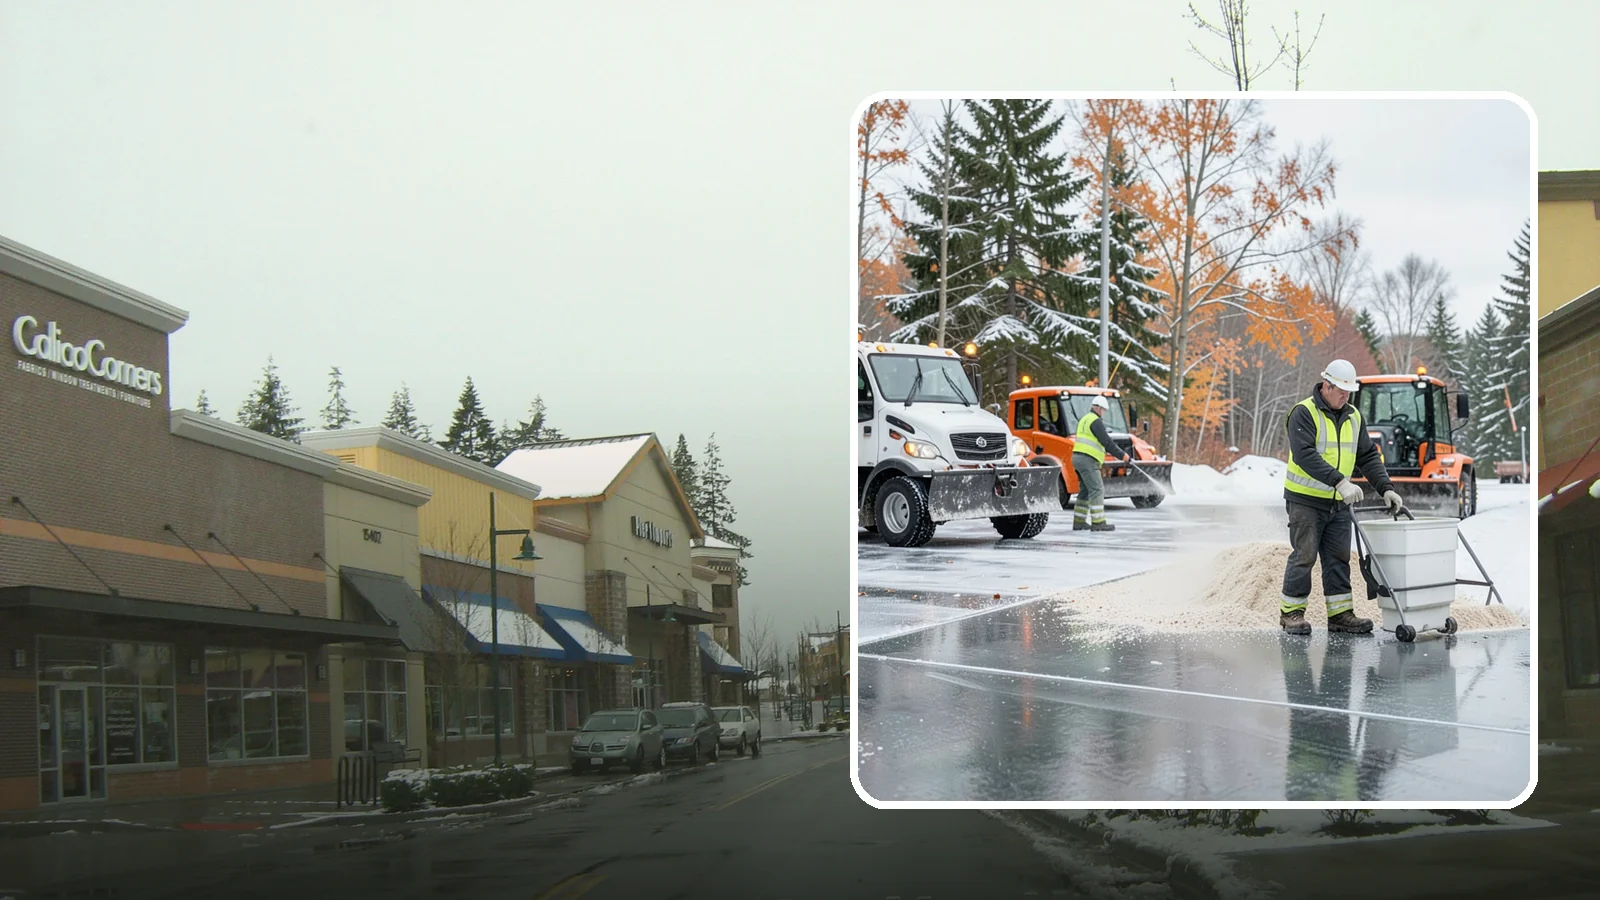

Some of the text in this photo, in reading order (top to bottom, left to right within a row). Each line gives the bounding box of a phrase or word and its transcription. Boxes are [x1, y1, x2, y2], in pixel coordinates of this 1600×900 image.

[17, 360, 151, 408] FABRICS WINDOW TREATMENTS FURNITURE
